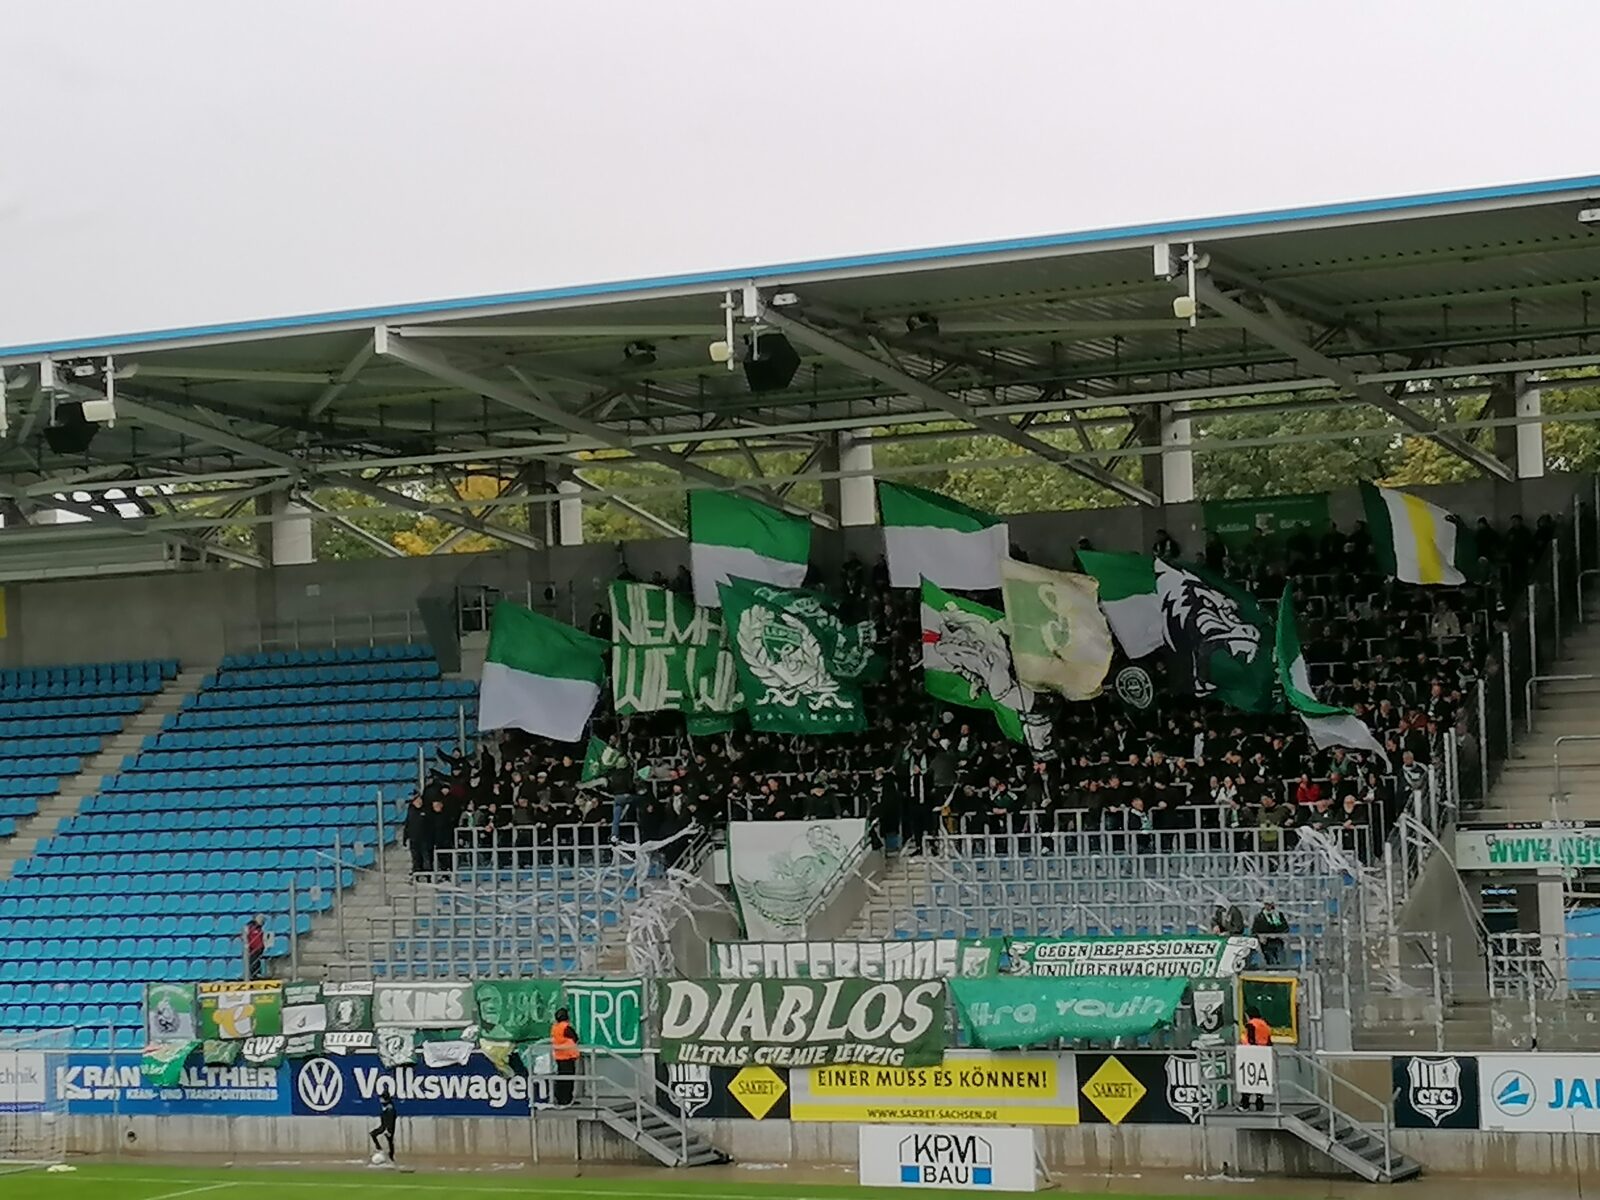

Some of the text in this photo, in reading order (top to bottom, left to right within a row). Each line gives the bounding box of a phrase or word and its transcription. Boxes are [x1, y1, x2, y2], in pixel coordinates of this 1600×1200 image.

[1037, 942, 1217, 958] GEGEN REPRESSIONEN
[379, 988, 464, 1020] SKINS
[661, 980, 943, 1043] DIABLOS
[566, 988, 639, 1045] TRC
[242, 1036, 284, 1056] GWP
[678, 1043, 905, 1066] ULTRAS CHEMIE LEIPZIG
[56, 1065, 141, 1098] KRAN
[178, 1066, 277, 1088] ALTHER
[818, 1066, 1048, 1088] EINER MUSS ES KÖNNEN!
[1239, 1061, 1271, 1087] 19A
[353, 1067, 552, 1108] Volkswagen
[674, 1083, 706, 1098] CFC
[1174, 1086, 1211, 1103] CFC
[1417, 1089, 1454, 1105] CFC
[914, 1133, 978, 1164] KPM
[923, 1166, 970, 1185] BAU
